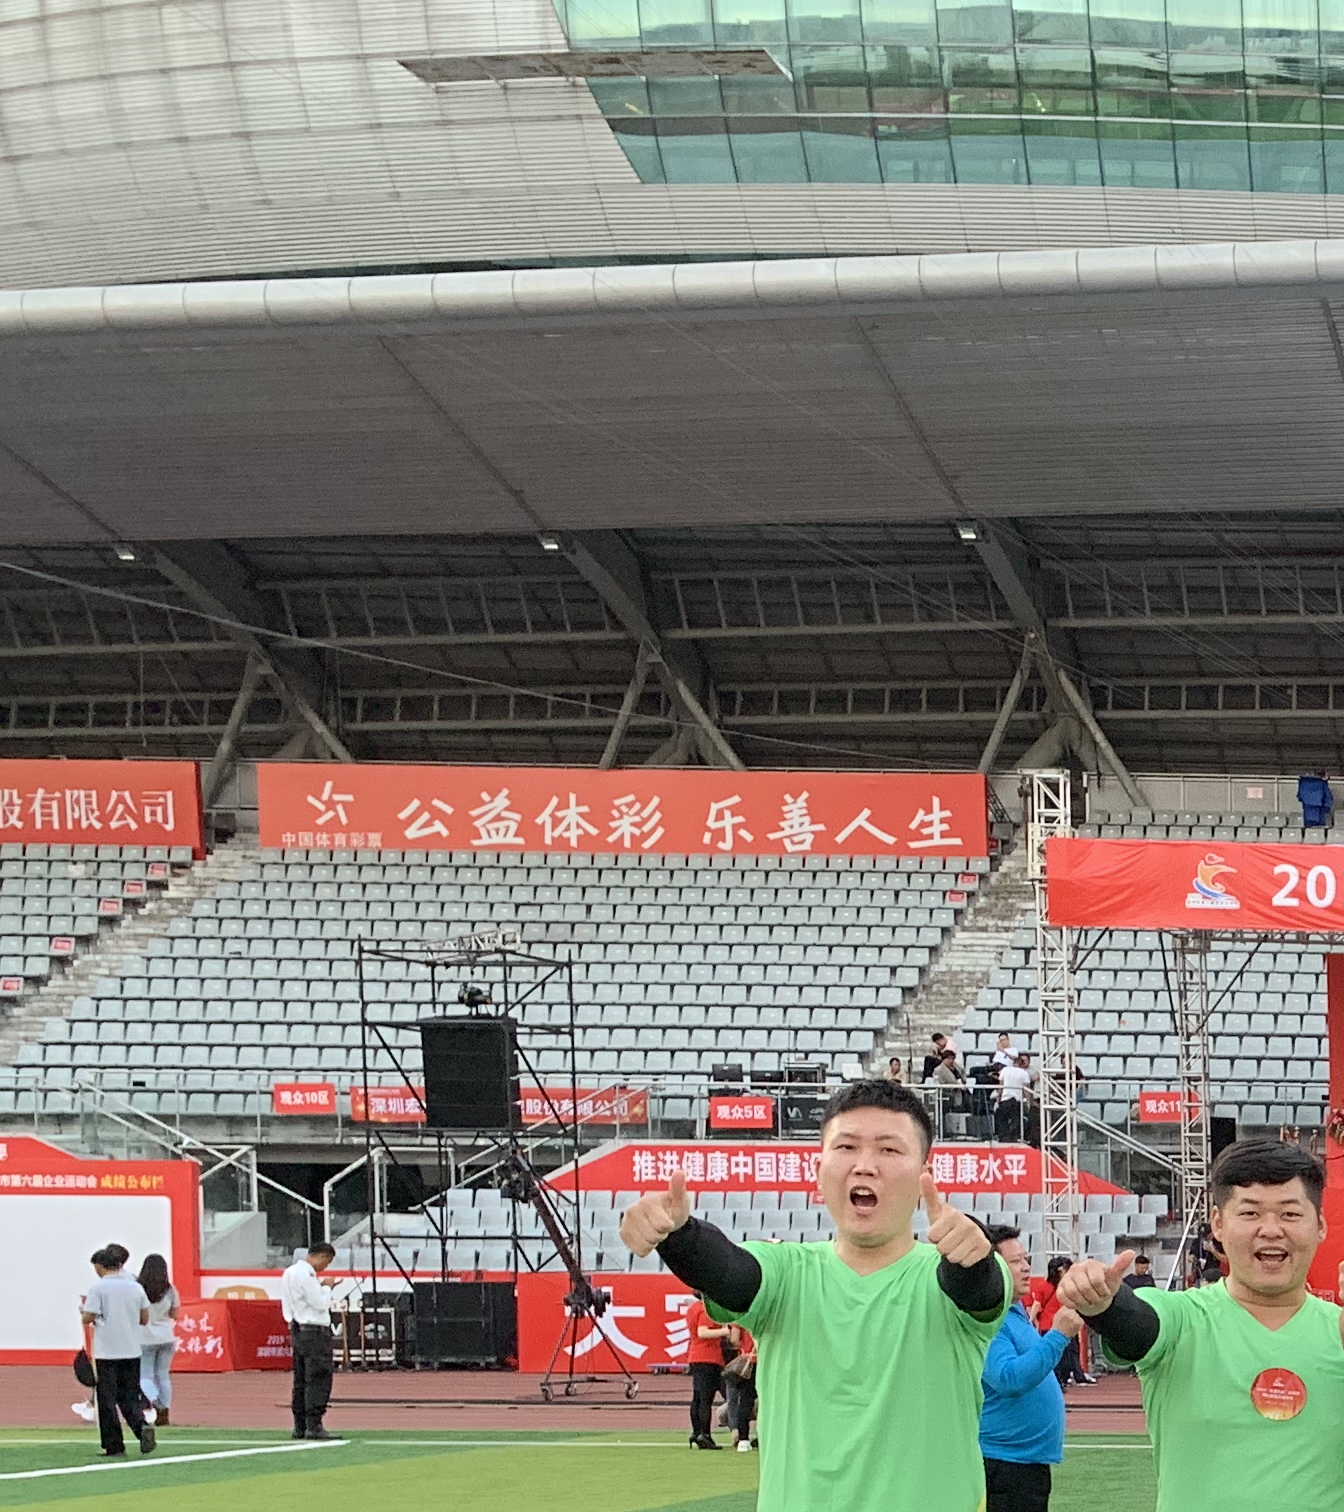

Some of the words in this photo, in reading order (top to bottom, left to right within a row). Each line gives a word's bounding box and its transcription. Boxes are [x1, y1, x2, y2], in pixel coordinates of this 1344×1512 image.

[0, 786, 176, 832] 股有限公司
[397, 787, 665, 850] 公益体彩
[702, 791, 963, 853] 乐善人生
[281, 831, 383, 848] 中国体育彩票
[279, 1090, 330, 1105] 观众10区
[716, 1104, 767, 1120] 观众5区
